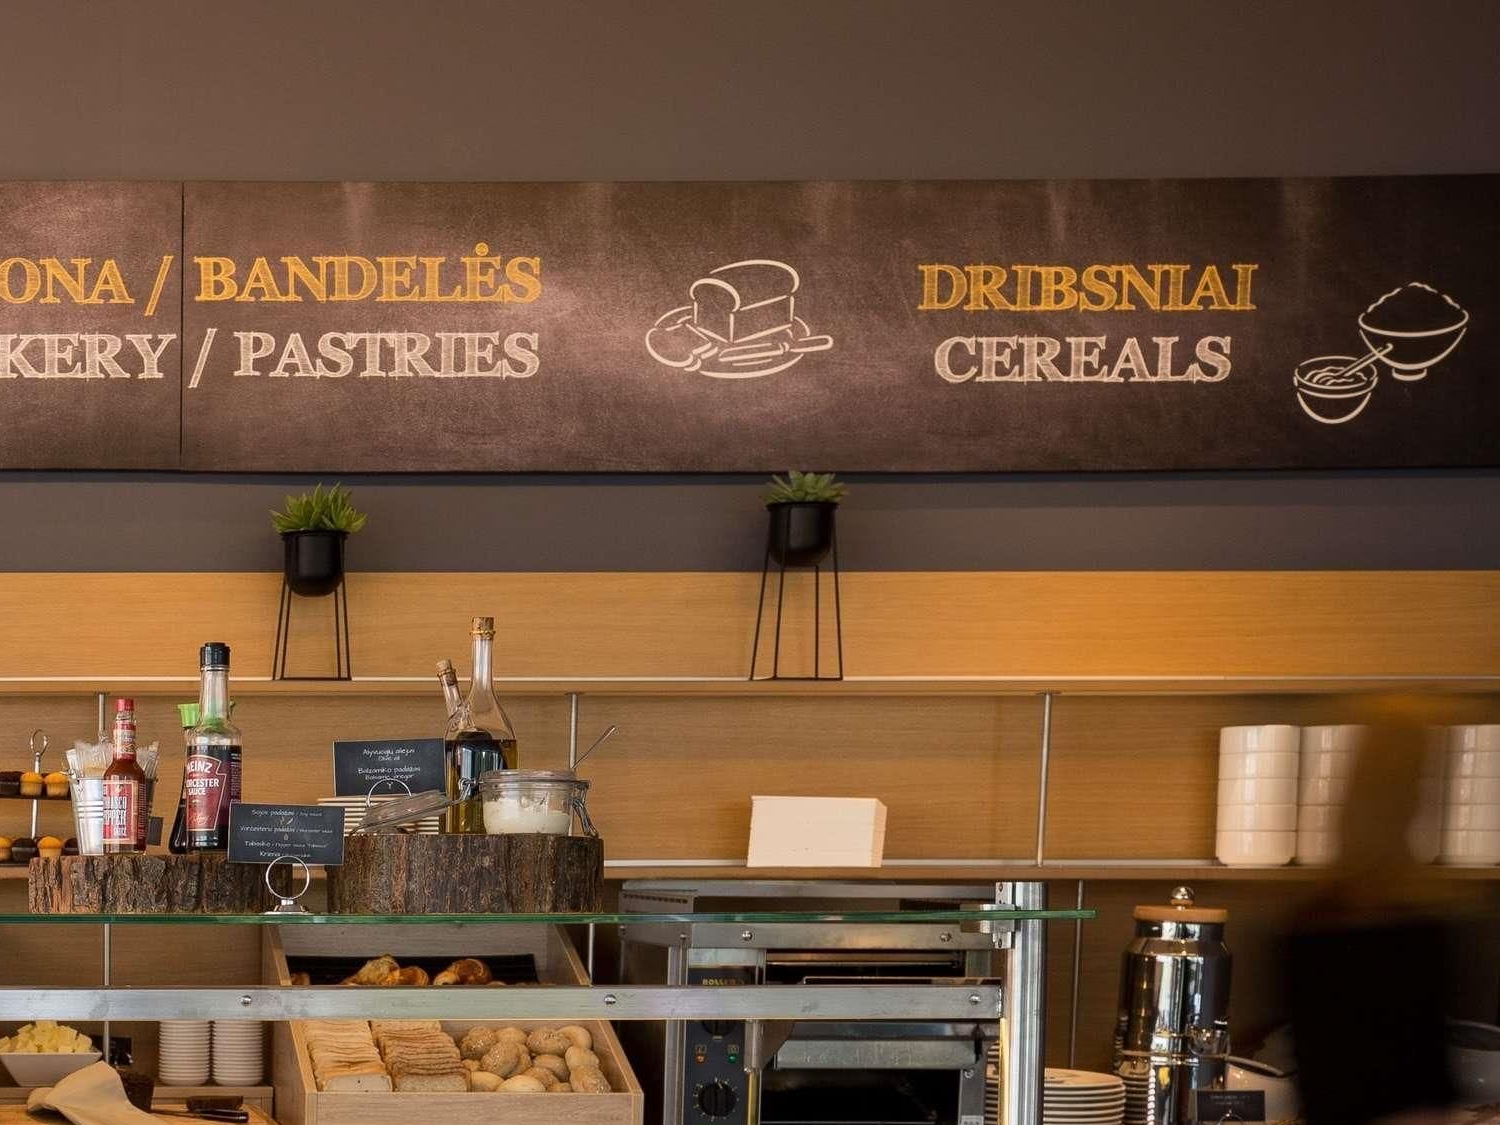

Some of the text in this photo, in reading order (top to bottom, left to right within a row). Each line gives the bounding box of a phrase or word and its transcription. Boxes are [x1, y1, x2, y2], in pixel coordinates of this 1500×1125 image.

[143, 256, 174, 316] /
[194, 243, 543, 303] BANDELĖS
[916, 262, 1258, 313] DRIBSNIAI
[188, 328, 217, 388] /
[234, 329, 542, 379] PASTRIES
[933, 335, 1232, 384] CEREALS
